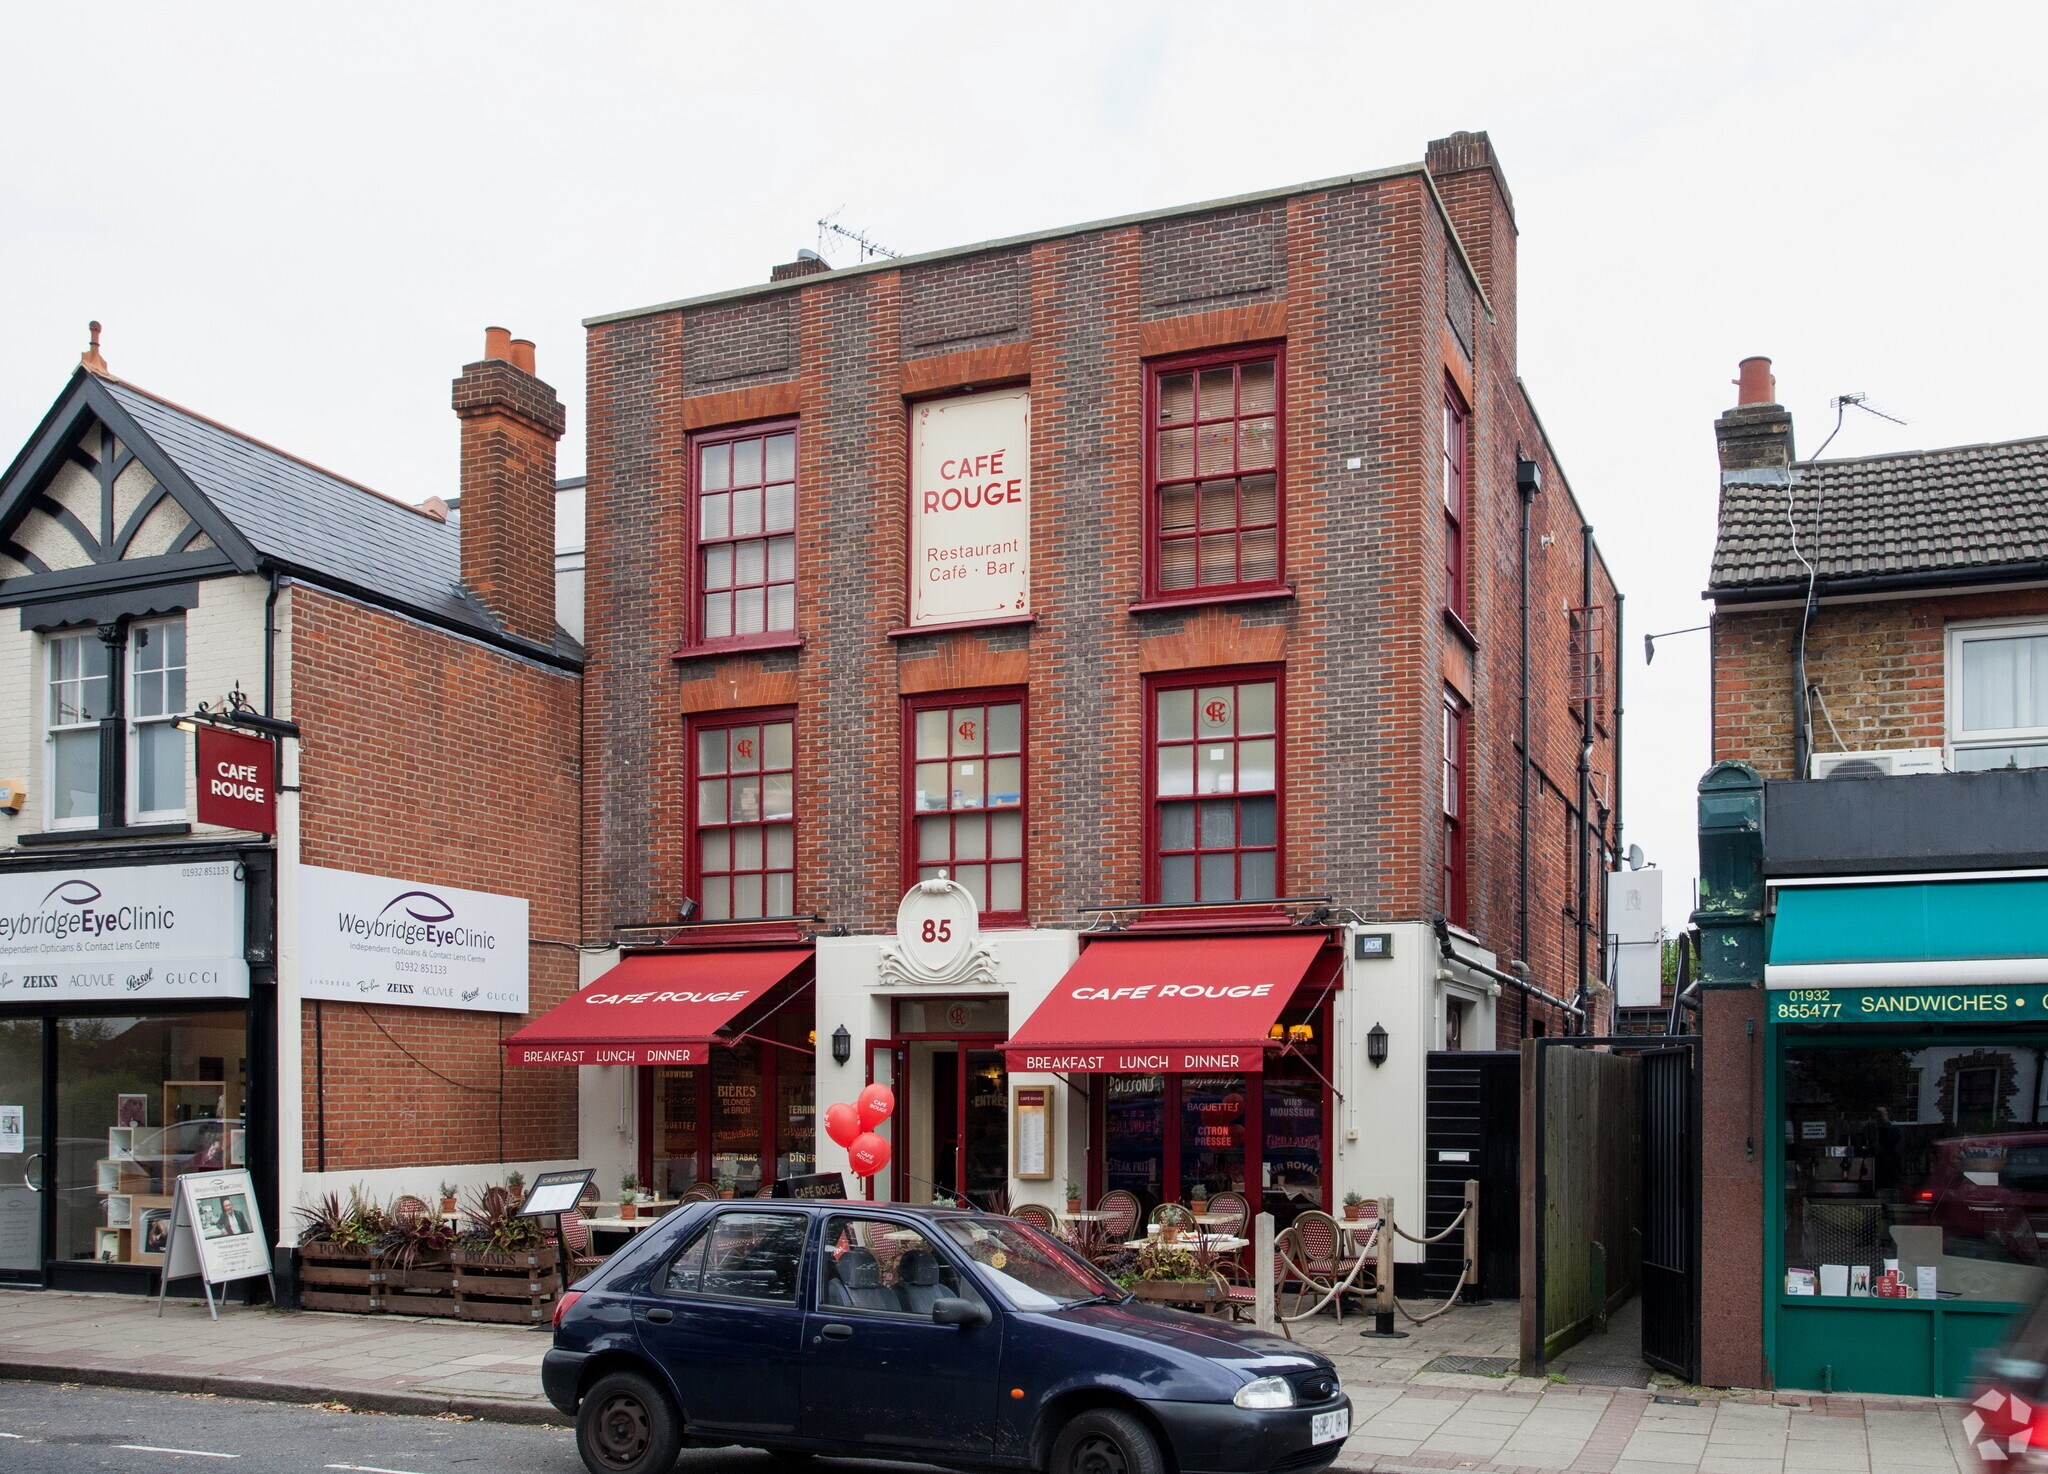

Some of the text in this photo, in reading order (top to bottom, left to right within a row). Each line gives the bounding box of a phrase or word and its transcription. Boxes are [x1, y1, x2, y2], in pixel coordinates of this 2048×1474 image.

[940, 449, 1006, 481] CAFÉ
[924, 479, 1022, 514] ROUGE
[927, 538, 1019, 562] Restaurant
[929, 560, 1015, 582] Café Bar
[211, 779, 264, 804] ROUGE
[182, 866, 229, 878] 01932 851133
[0, 905, 175, 940] eybridgeEyeClinic
[338, 912, 496, 950] WeybridgeEyeClinic
[921, 919, 951, 943] 85
[0, 940, 160, 956] dependent Opticians & Contact Lens Centre
[349, 942, 486, 964] Independent Opticians & Contact Lens Centre
[395, 961, 447, 975] 01932 851133
[23, 975, 59, 989] ZEISS
[69, 973, 116, 987] ACUVUE
[126, 967, 155, 991] Persol
[166, 971, 219, 985] GUCCI
[309, 979, 351, 988] LINDBERG
[387, 982, 414, 994] ZEISS
[422, 986, 454, 998] ACUVUE
[461, 987, 481, 1002] Persol
[487, 991, 519, 1002] GUCCI
[655, 990, 750, 1003] ROUGE
[1158, 983, 1275, 998] ROUGE
[1789, 989, 1830, 1002] 01932
[1777, 1003, 1842, 1018] 855477
[1860, 994, 2008, 1013] SANDWICHES
[523, 1049, 690, 1062] BREAKFAST LUNCH DINNER
[1026, 1054, 1239, 1069] BREAKFAST LUNCH DINNER
[717, 1083, 756, 1098] BIÈRES
[1109, 1076, 1156, 1092] POISSONS
[722, 1098, 751, 1106] BLONDE
[788, 1105, 815, 1114] TERRIN
[1187, 1102, 1239, 1112] BAGUETTES
[1283, 1098, 1302, 1106] VINS
[731, 1106, 751, 1114] BRUN
[1270, 1107, 1315, 1117] MOUSSEUX
[1197, 1126, 1229, 1136] CITRON
[716, 1153, 758, 1161] BAR TABAC
[1286, 1161, 1319, 1177] ROYAL
[560, 1174, 586, 1182] ROUGE
[815, 1183, 841, 1197] ROUGE
[319, 1243, 368, 1256] POMMES
[464, 1253, 516, 1265] POMMES
